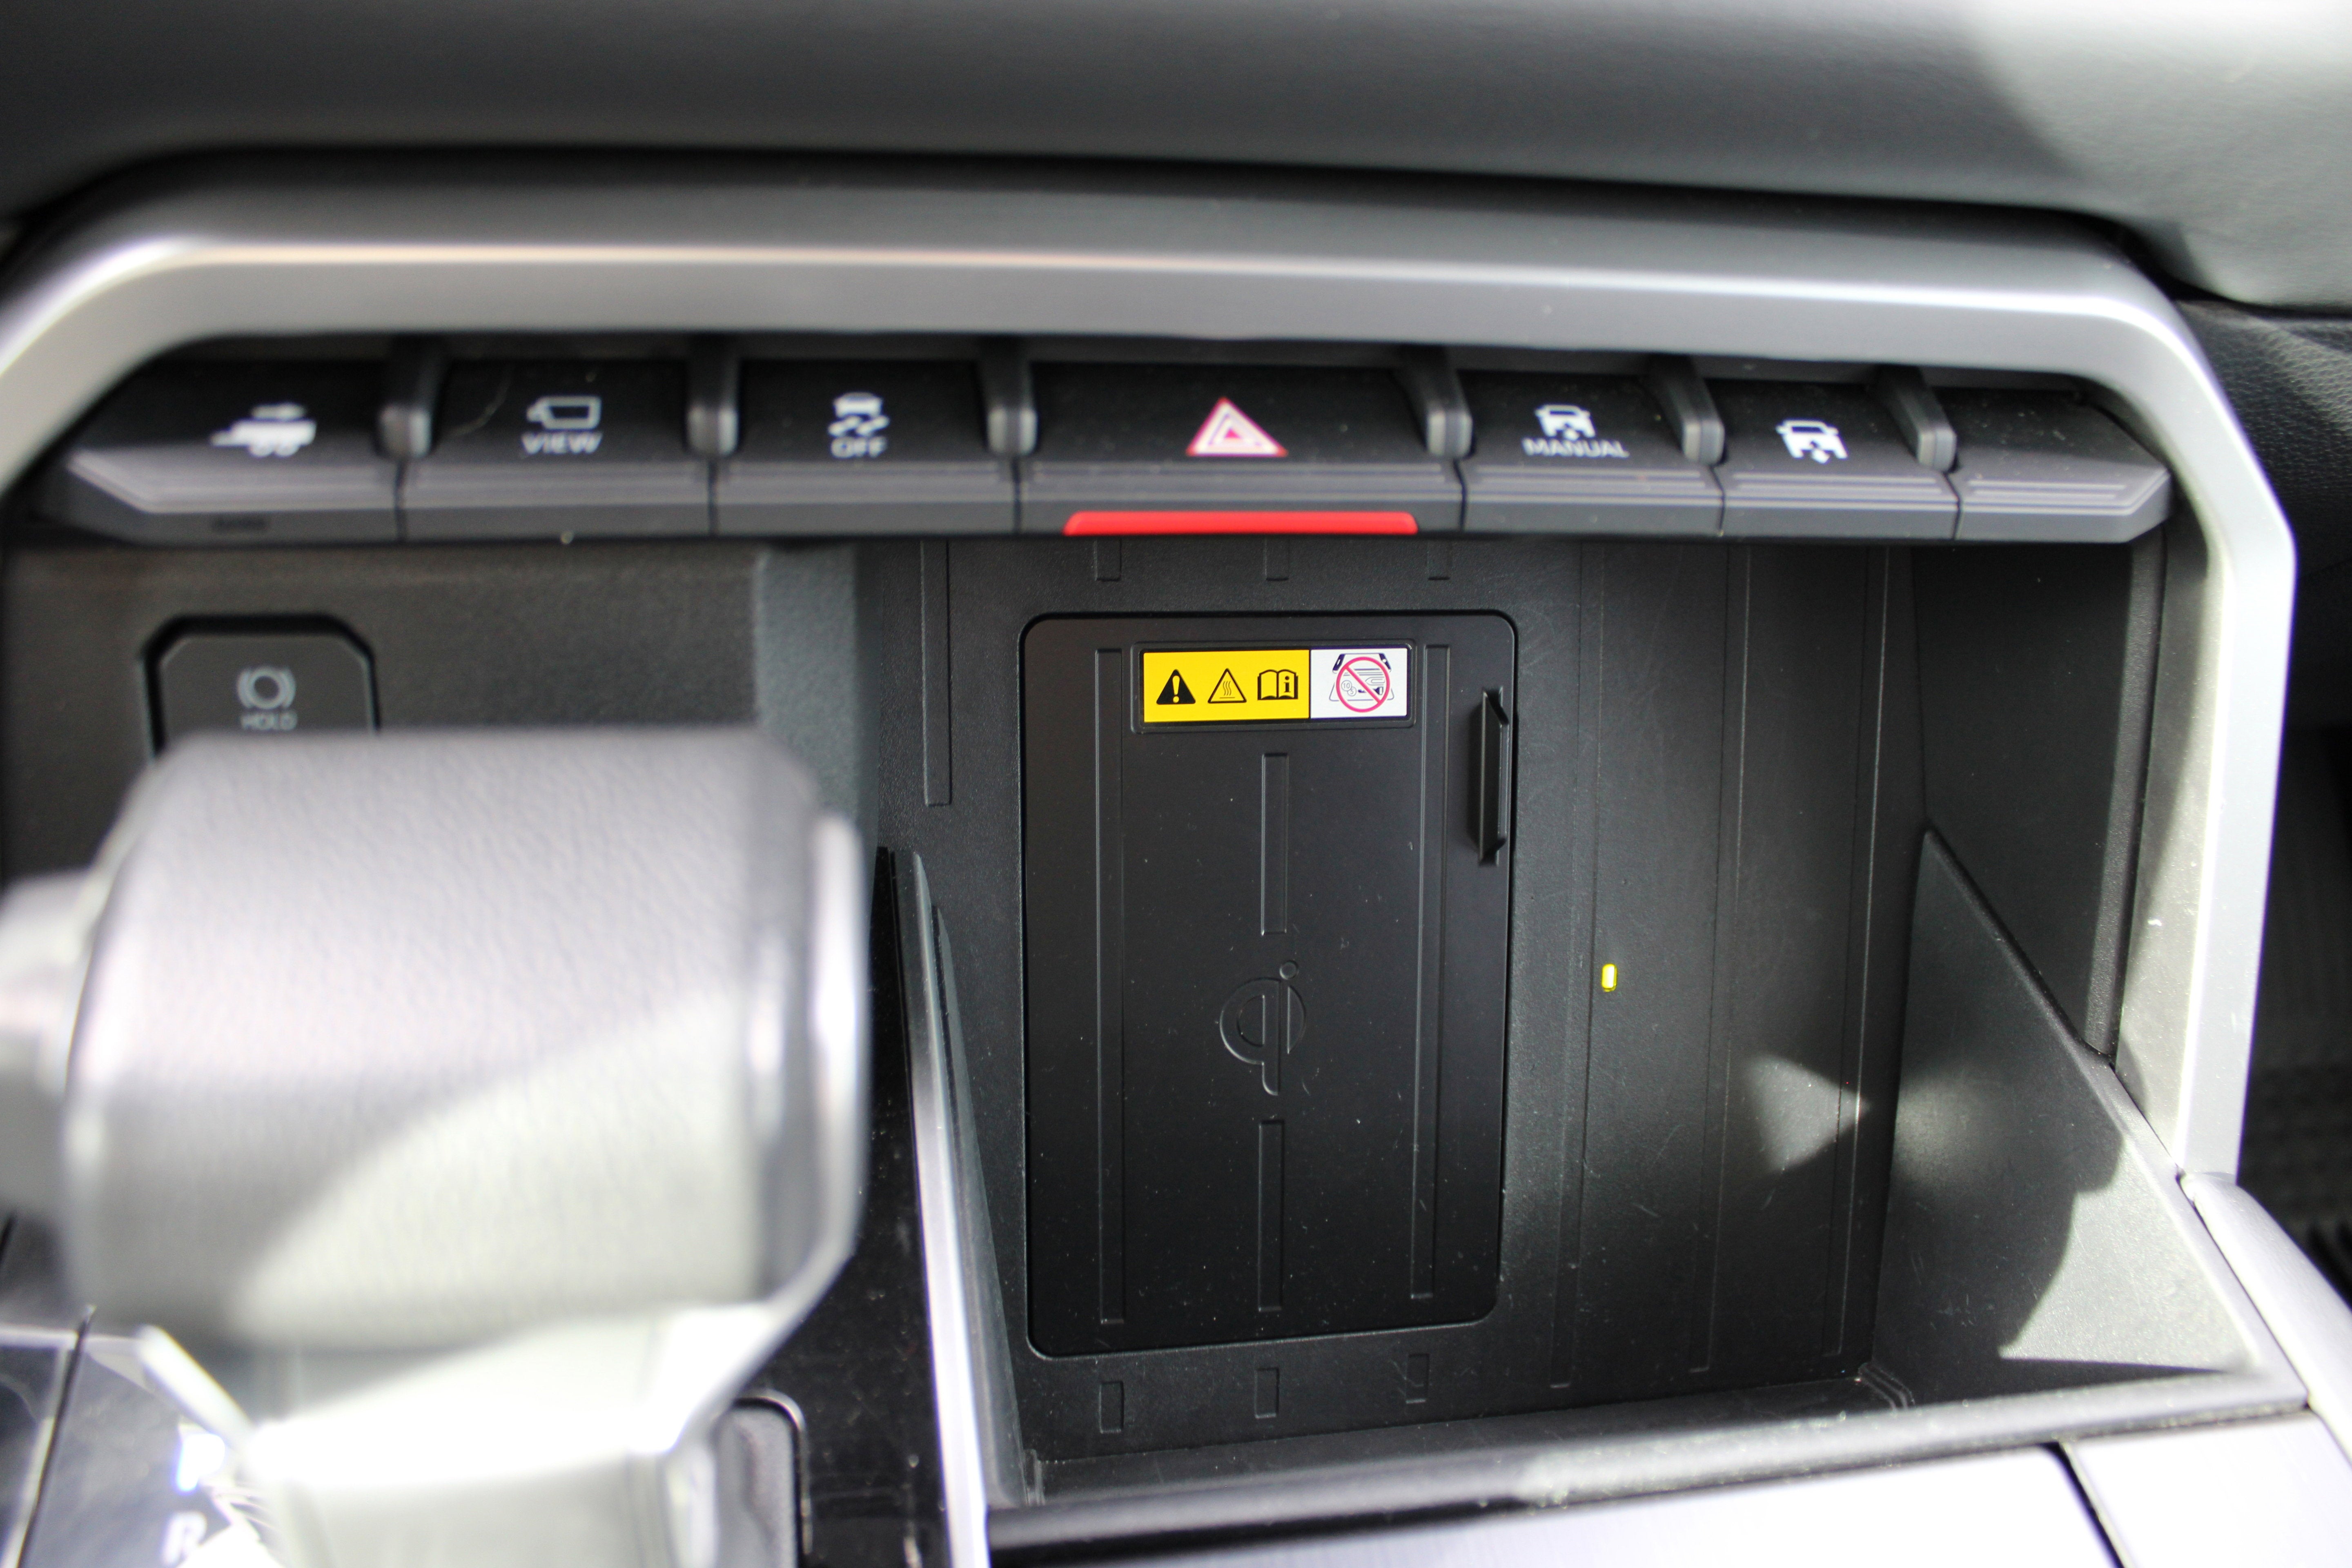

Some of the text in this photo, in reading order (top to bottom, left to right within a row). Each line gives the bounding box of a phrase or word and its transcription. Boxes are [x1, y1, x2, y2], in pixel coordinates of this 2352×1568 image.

[521, 432, 603, 454] VIEW
[831, 437, 887, 458] OFF
[1522, 438, 1630, 458] MANUAL
